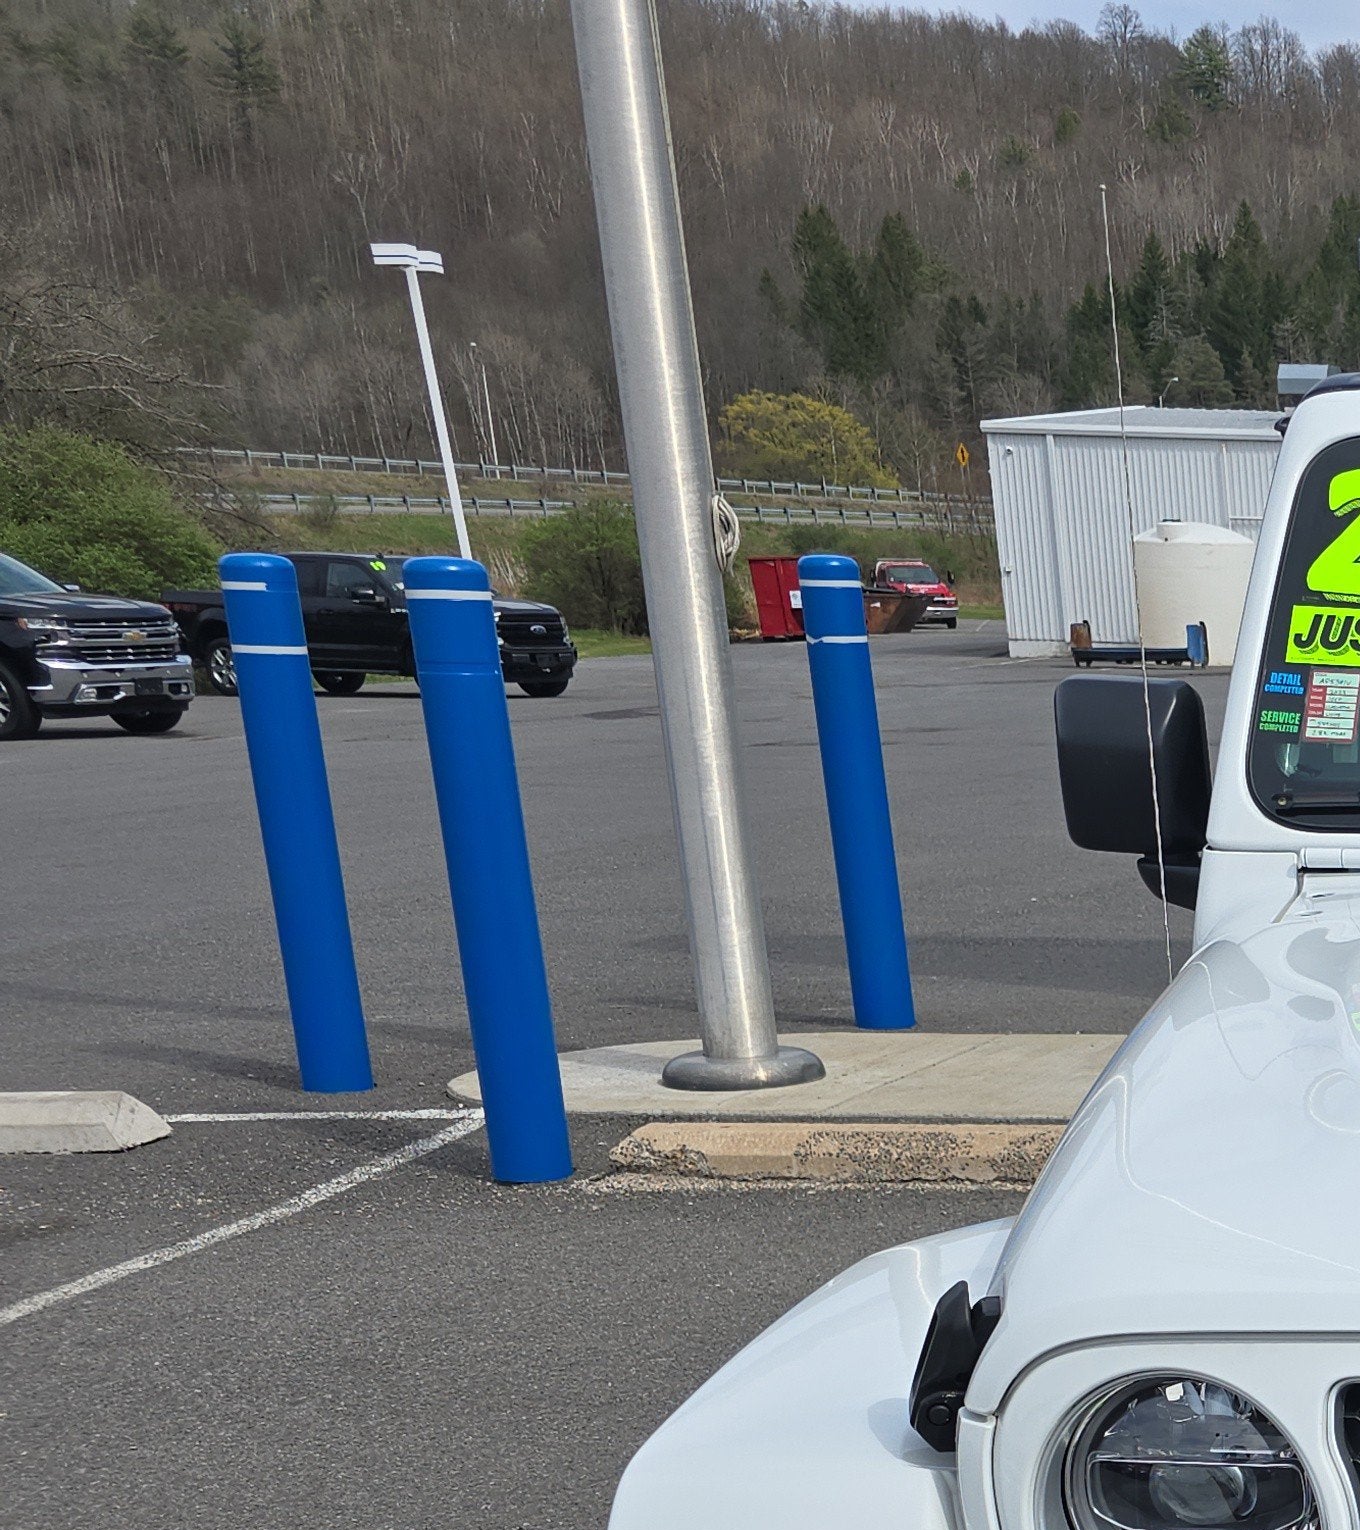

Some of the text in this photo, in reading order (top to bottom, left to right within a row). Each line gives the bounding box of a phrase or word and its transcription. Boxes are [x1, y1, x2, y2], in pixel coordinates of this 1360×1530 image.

[1270, 672, 1302, 686] DETAIL
[1264, 684, 1305, 695] COMPLETED
[1260, 711, 1301, 725] SERVICE
[1259, 723, 1299, 733] COMPLETED
